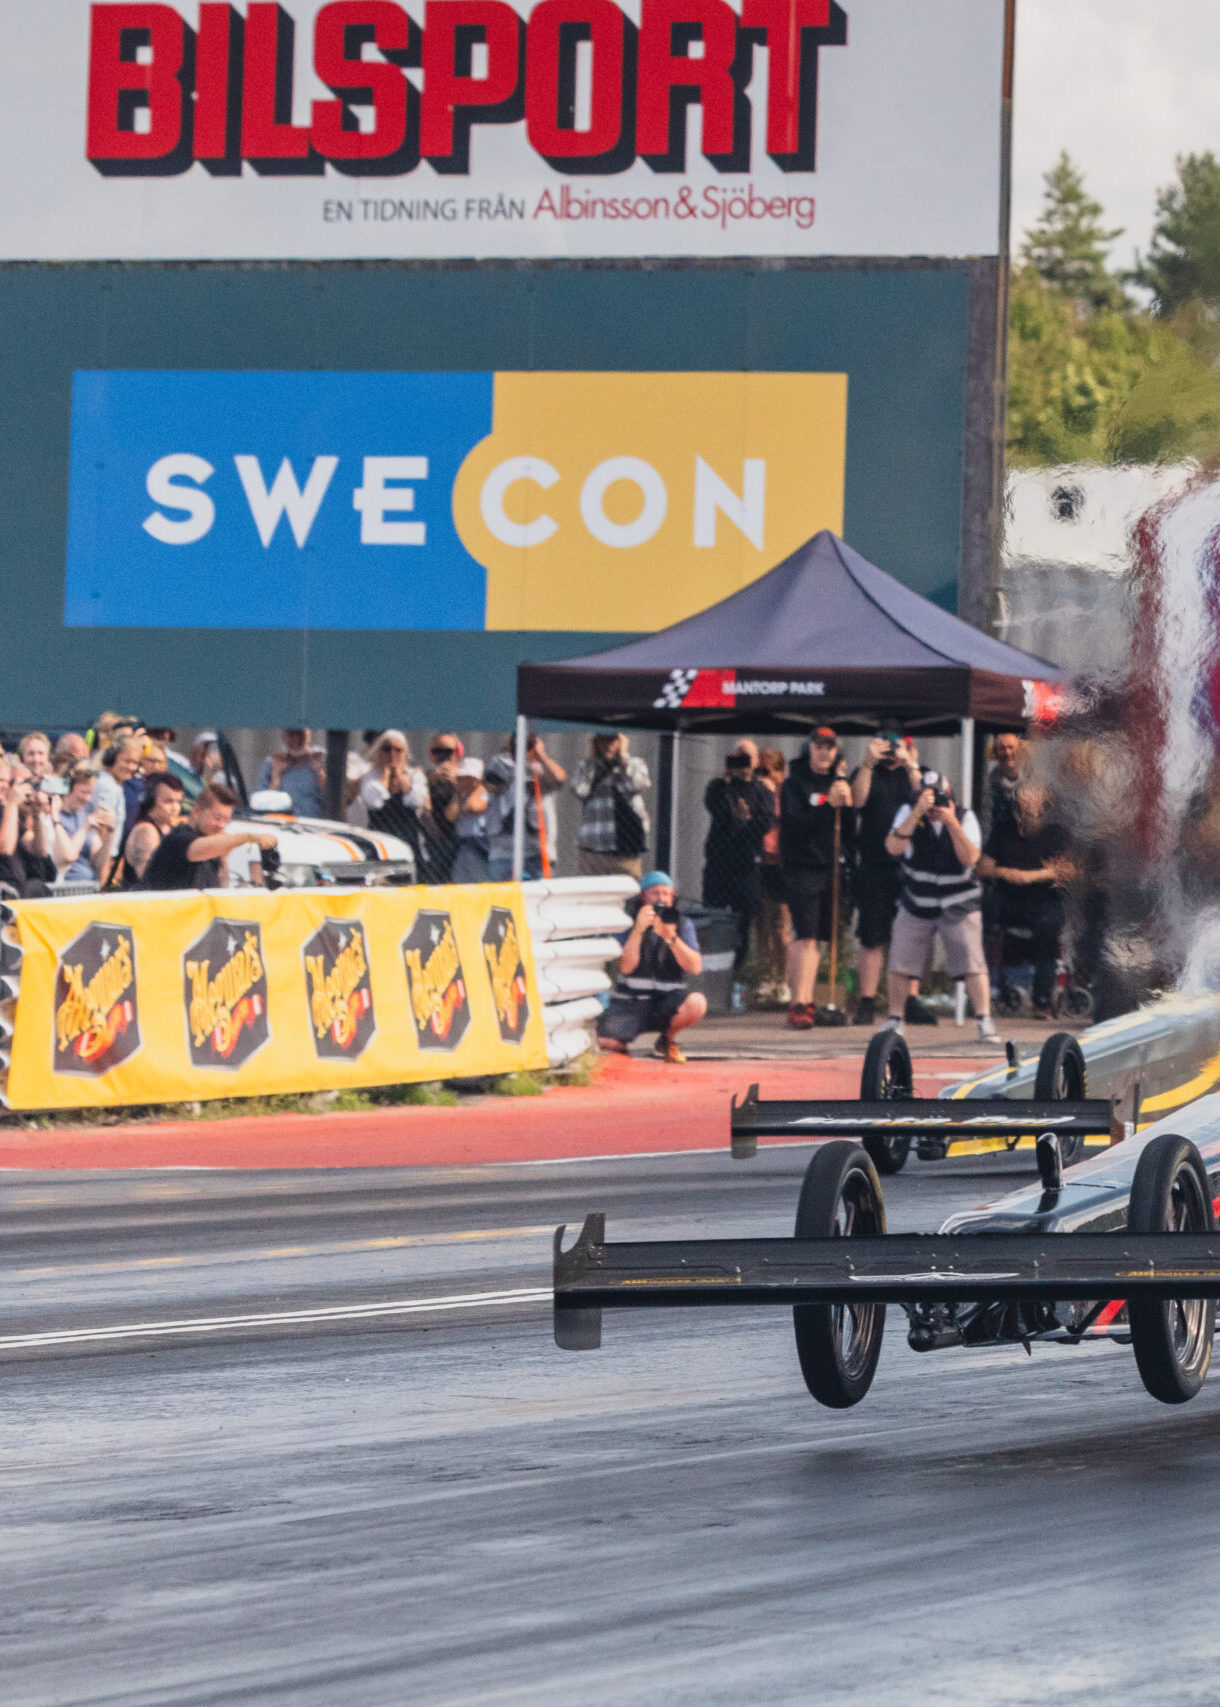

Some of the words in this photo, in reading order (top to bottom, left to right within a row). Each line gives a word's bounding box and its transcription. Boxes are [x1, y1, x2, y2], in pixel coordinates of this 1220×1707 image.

[86, 0, 846, 177] BILSPORT
[322, 199, 354, 222] EN
[360, 198, 457, 221] TIDNING
[464, 192, 526, 220] FRÅN
[142, 452, 766, 551] SWECON
[721, 680, 788, 695] MANTORP
[789, 681, 826, 695] PARK
